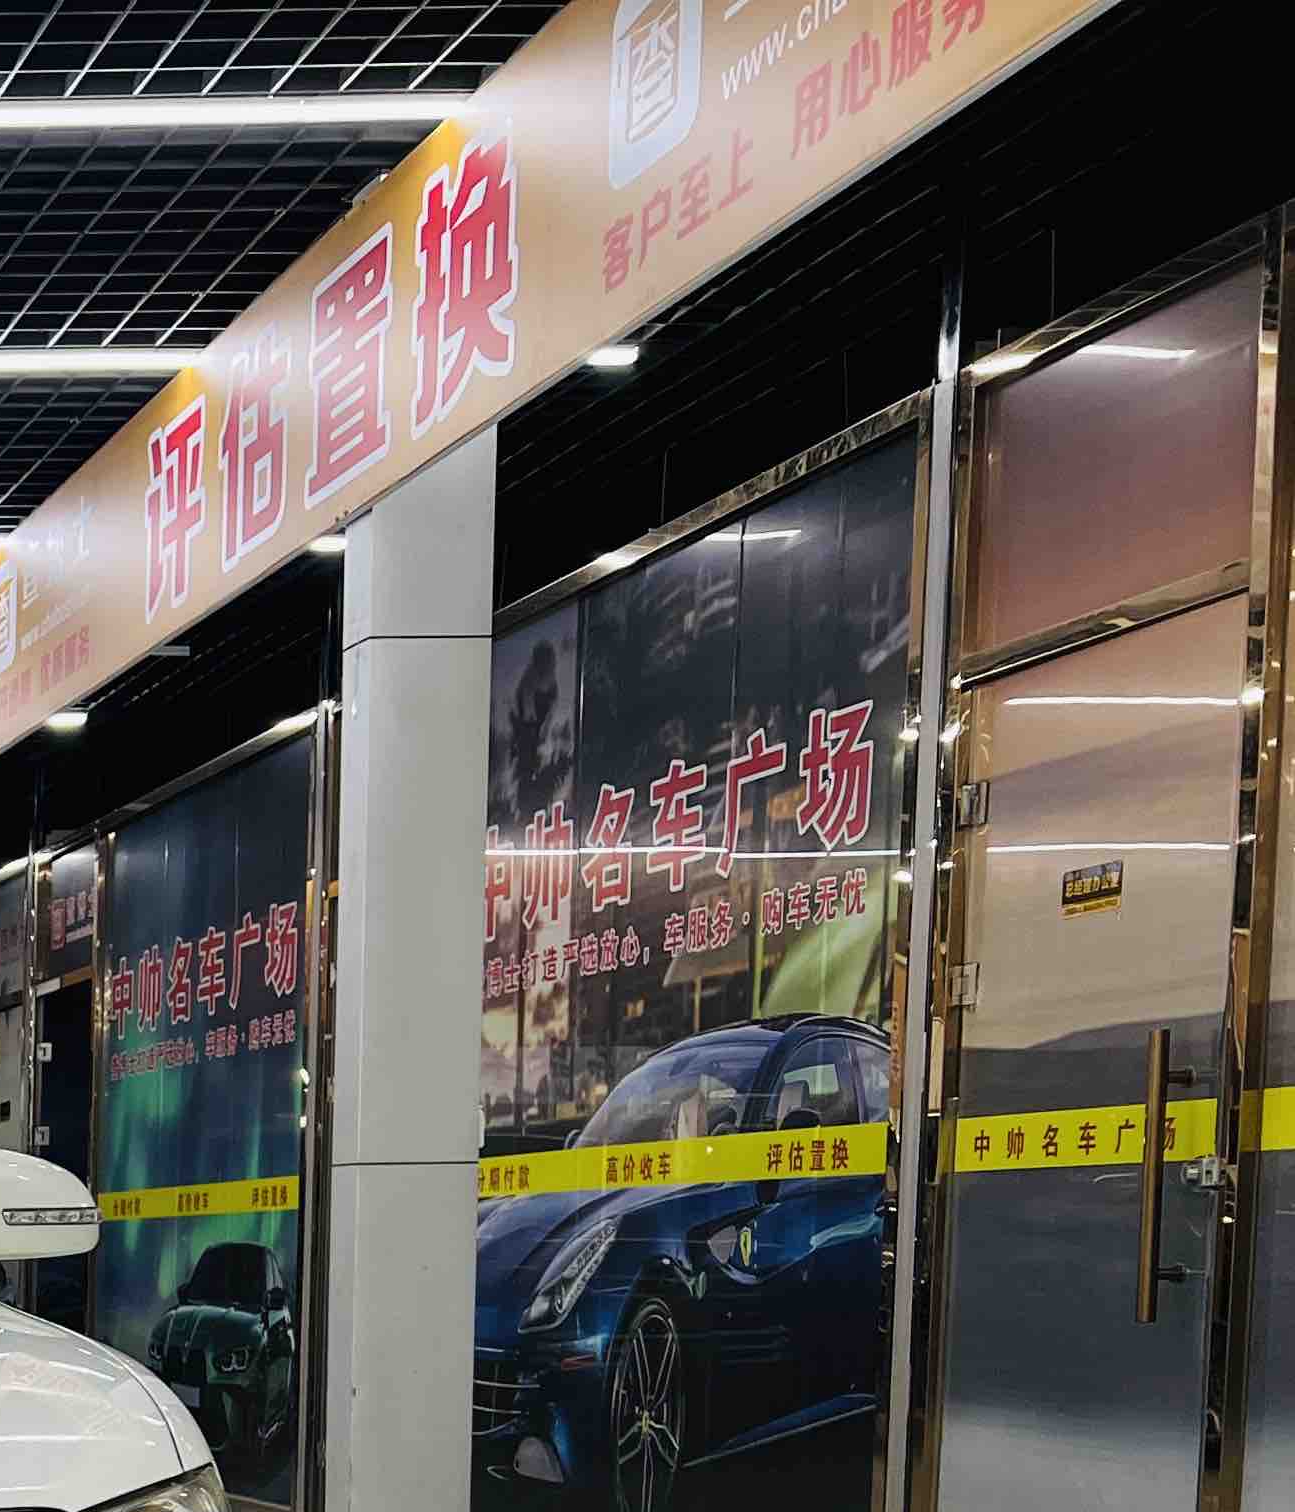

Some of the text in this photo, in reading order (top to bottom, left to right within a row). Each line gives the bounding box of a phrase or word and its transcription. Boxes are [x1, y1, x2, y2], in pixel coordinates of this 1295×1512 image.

[601, 128, 755, 295] 客户至上
[145, 113, 519, 624] 评估置换
[483, 698, 874, 944] 中帅名车广场
[108, 901, 298, 1040] 中帅名车广场
[605, 1152, 672, 1186] 高价收车
[766, 1138, 849, 1173] 评估置换
